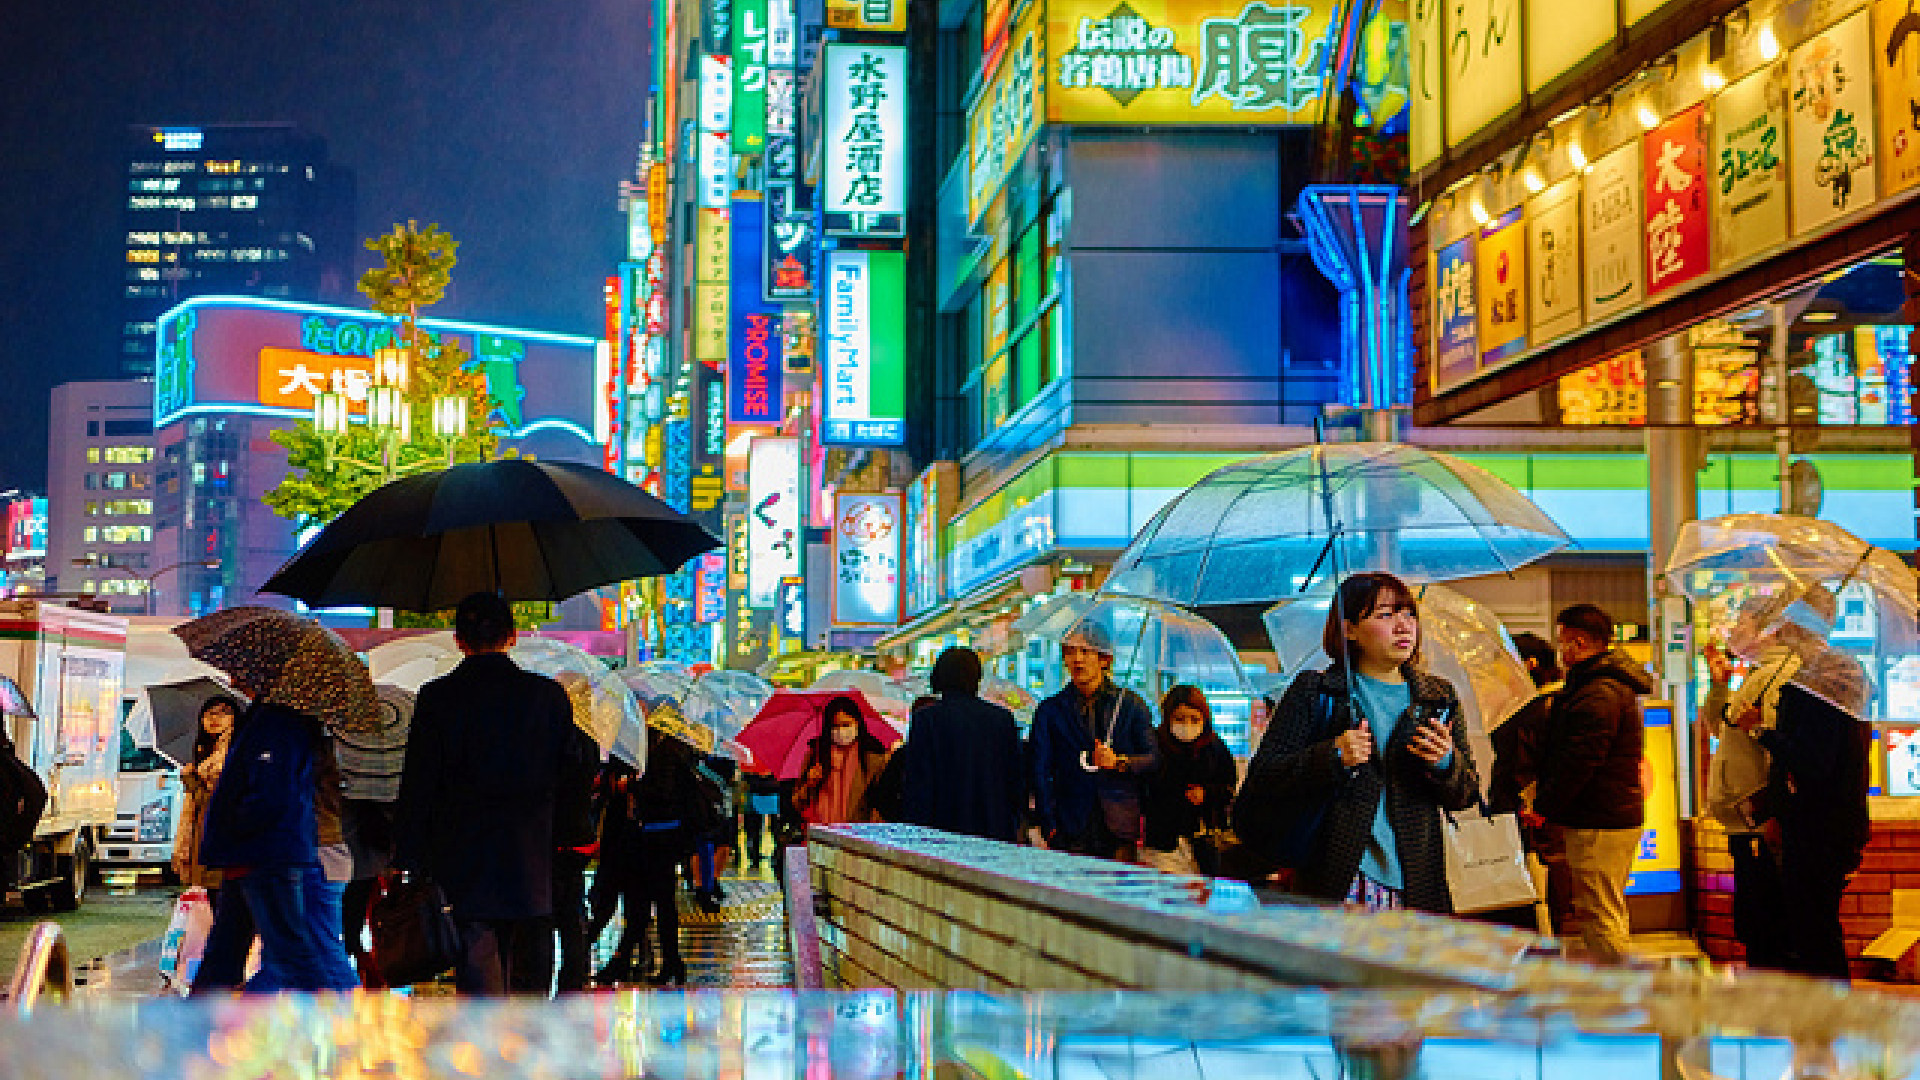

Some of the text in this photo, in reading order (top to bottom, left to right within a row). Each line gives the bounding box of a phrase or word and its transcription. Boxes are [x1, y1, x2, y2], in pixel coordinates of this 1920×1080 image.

[742, 10, 766, 92] レイク
[842, 52, 889, 206] 水野屋酒店
[743, 312, 770, 416] PROMISE
[827, 263, 862, 407] FamilyMart
